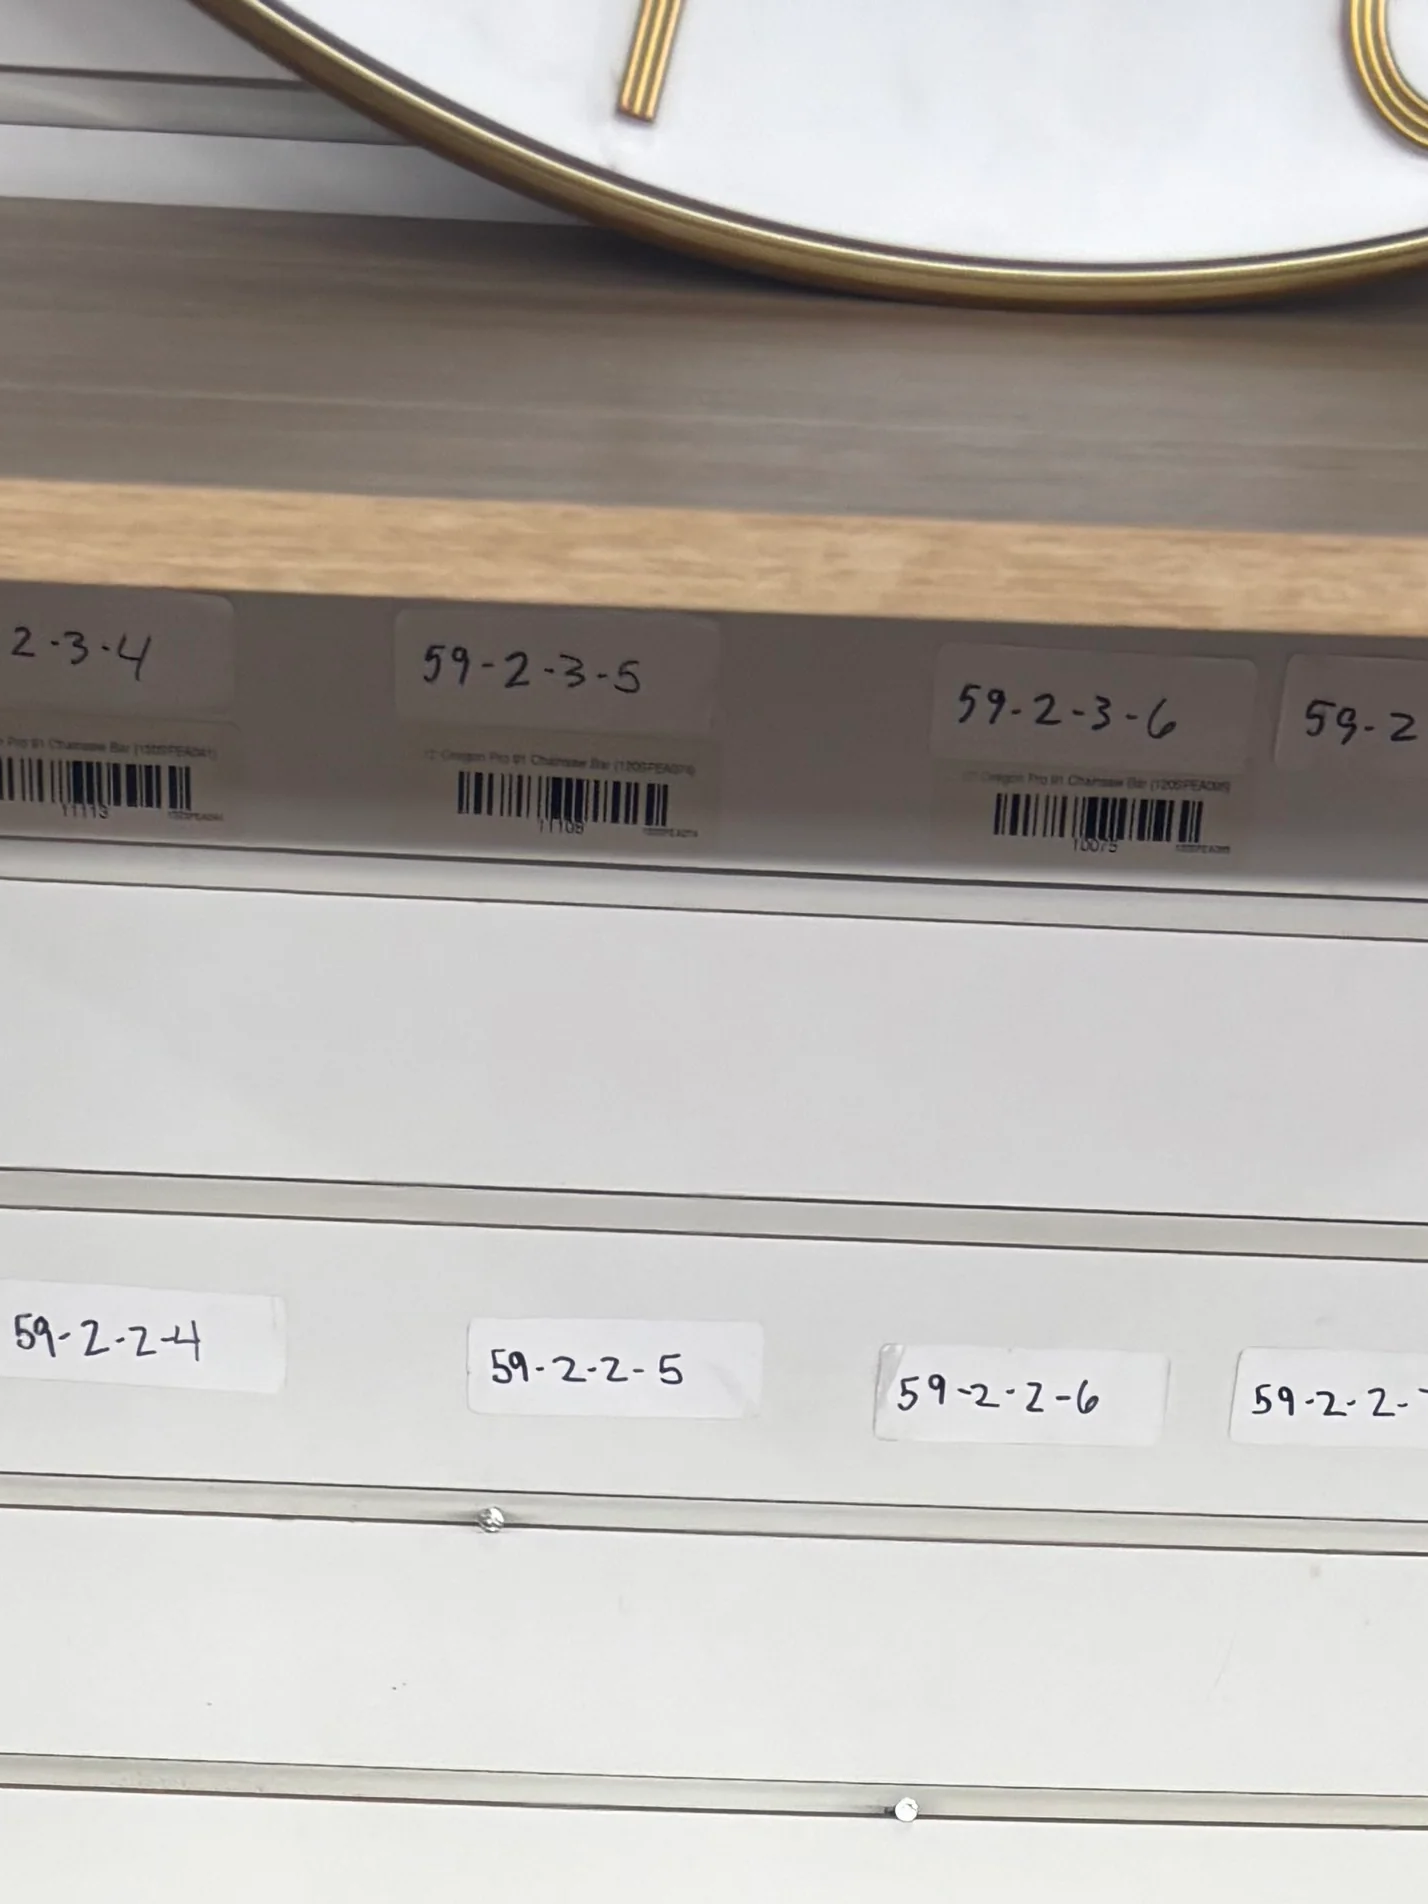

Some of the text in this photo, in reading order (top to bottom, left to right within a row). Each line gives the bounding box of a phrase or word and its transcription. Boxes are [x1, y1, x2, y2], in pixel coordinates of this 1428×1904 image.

[423, 644, 641, 694] 59-2-3-5
[958, 683, 1177, 740] 59-2-3-6
[14, 1312, 201, 1362] 59-2-2-4
[490, 1348, 684, 1385] 59-2-2-5
[897, 1373, 1100, 1415] 59-2-2-6
